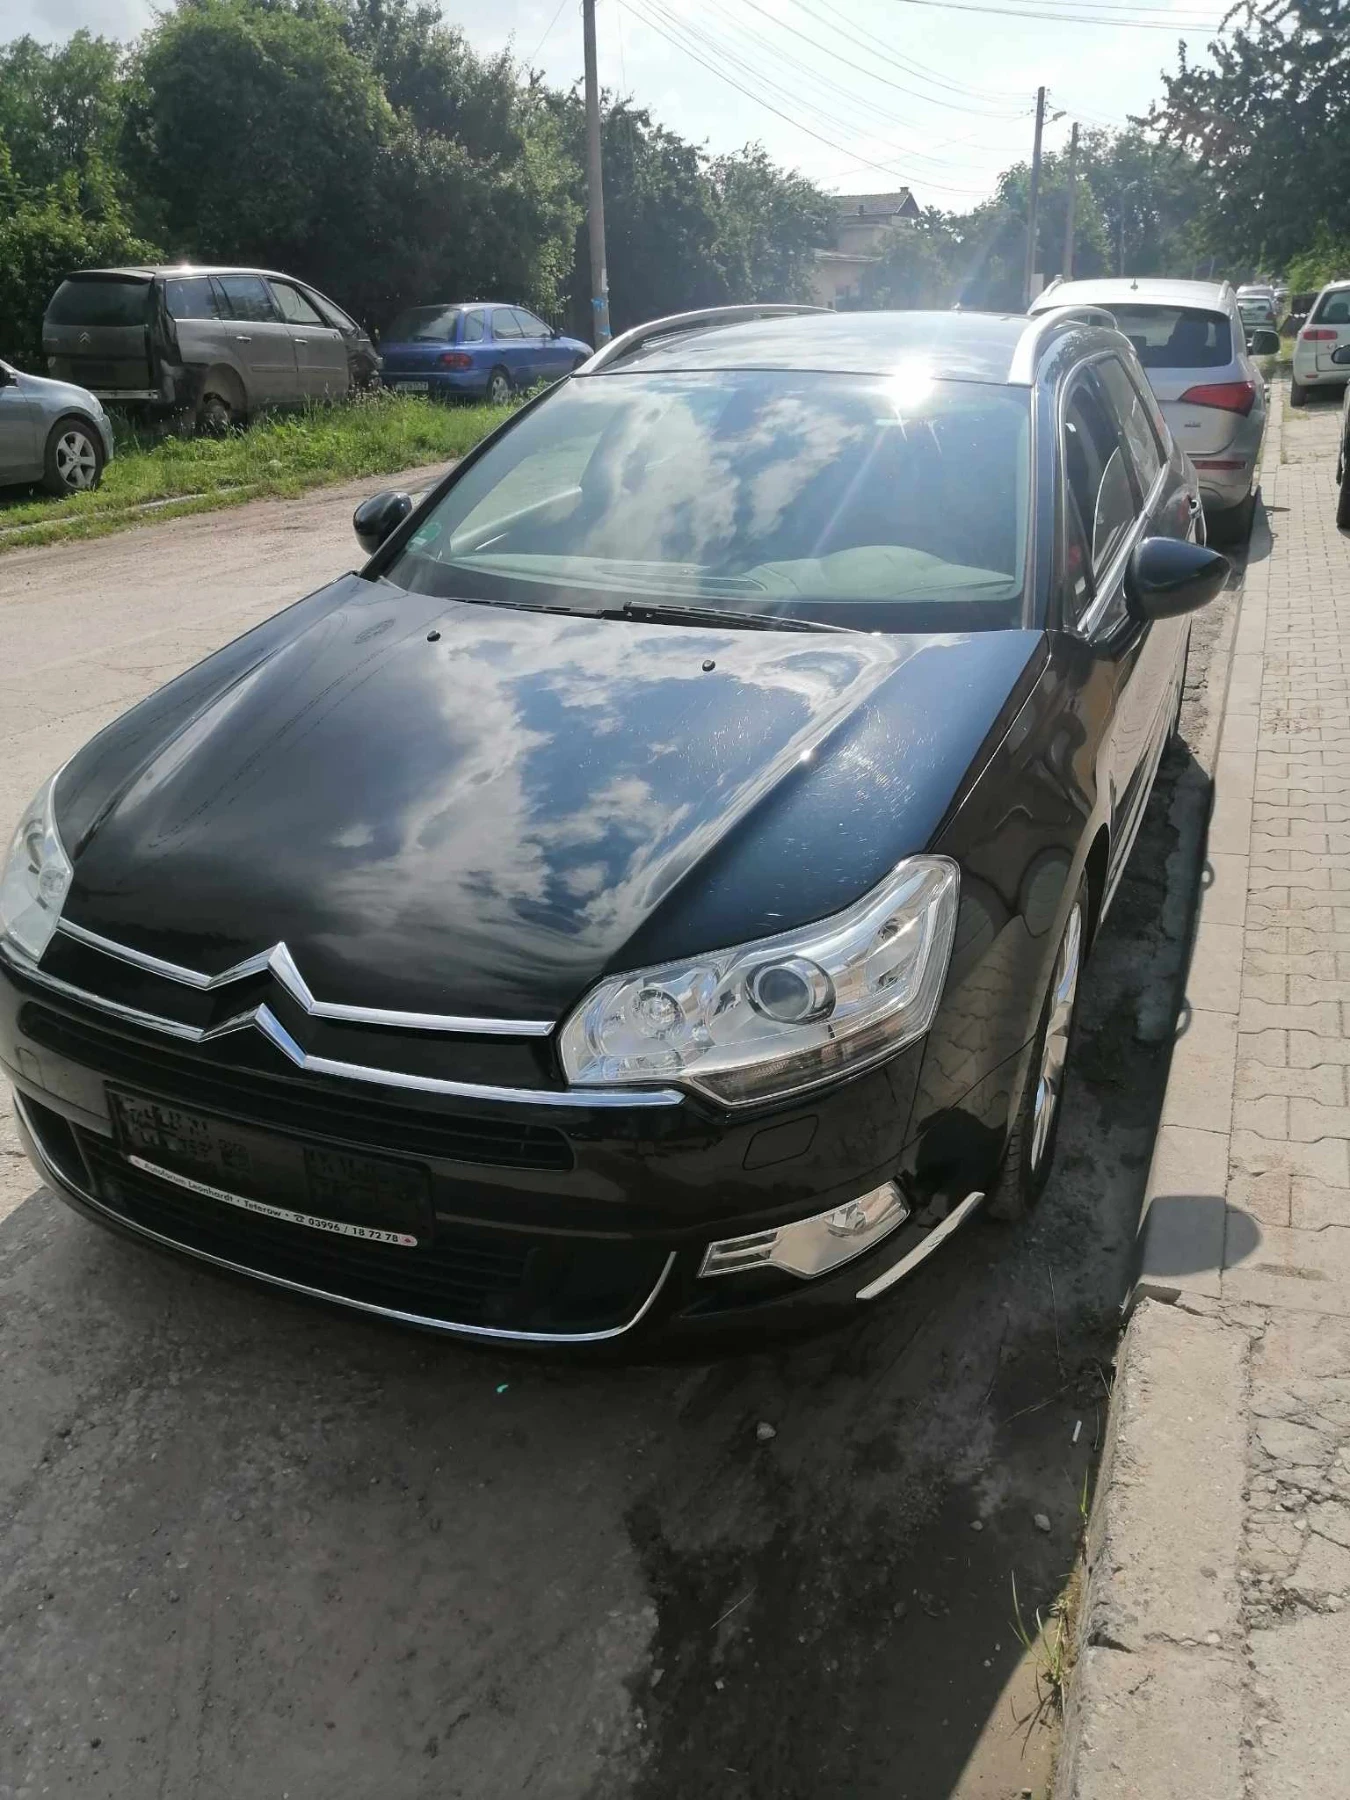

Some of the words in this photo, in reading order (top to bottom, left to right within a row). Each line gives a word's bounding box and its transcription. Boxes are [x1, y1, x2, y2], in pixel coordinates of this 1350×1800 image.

[308, 1217, 340, 1232] 03996
[352, 1226, 365, 1237] 18
[368, 1230, 382, 1240] 72
[385, 1233, 399, 1243] 78
